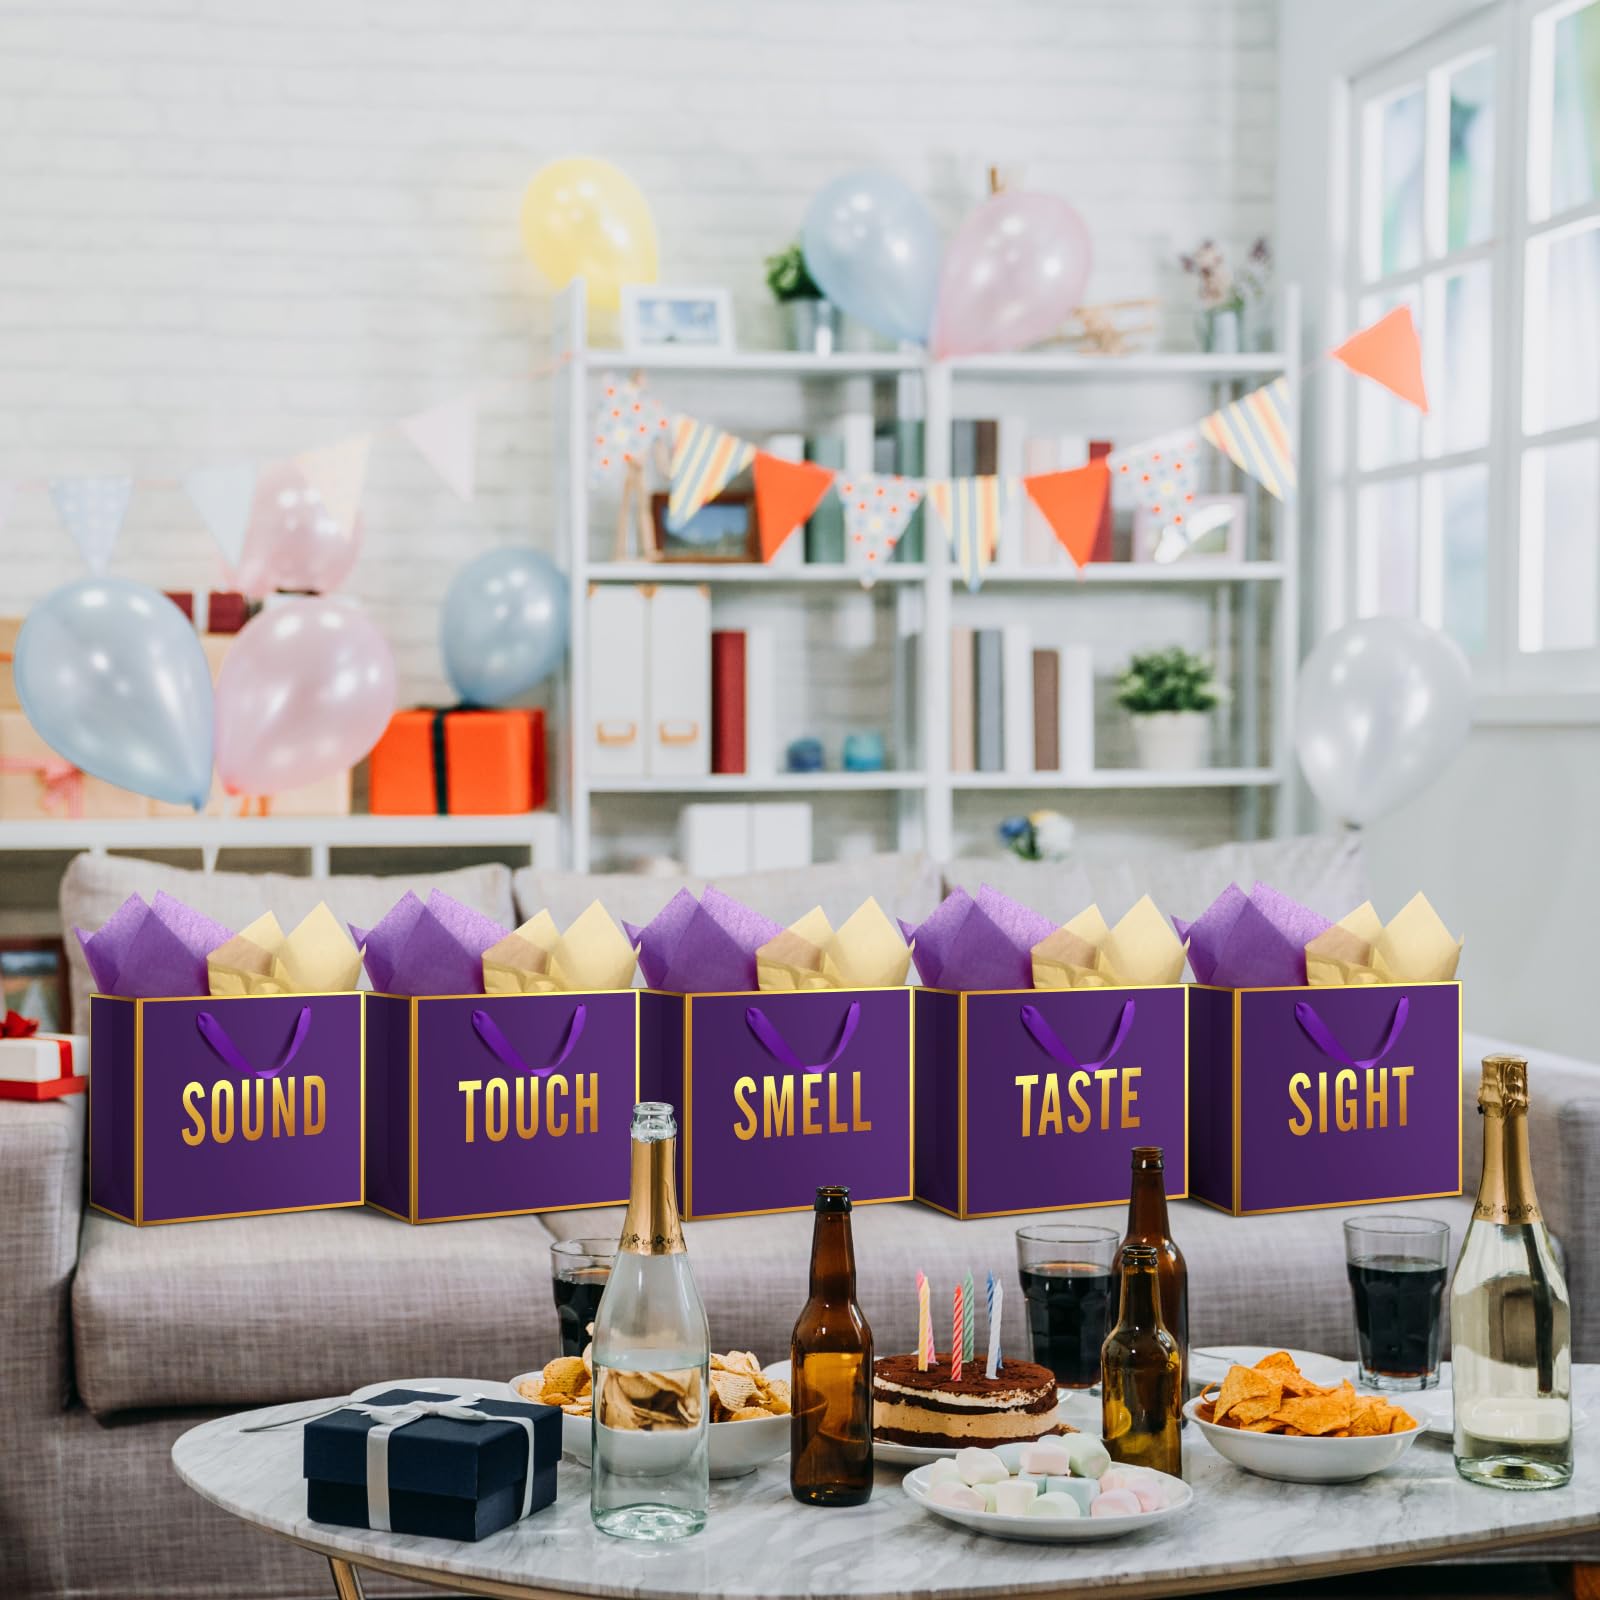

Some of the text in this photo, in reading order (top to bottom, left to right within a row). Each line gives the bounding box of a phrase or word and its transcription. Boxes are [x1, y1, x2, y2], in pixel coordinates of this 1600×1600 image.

[181, 1075, 327, 1147] SOUND
[458, 1072, 599, 1143] TOUCH
[733, 1071, 872, 1141] SMELL
[1014, 1067, 1142, 1137] TASTE
[1288, 1065, 1415, 1136] SIGHT
